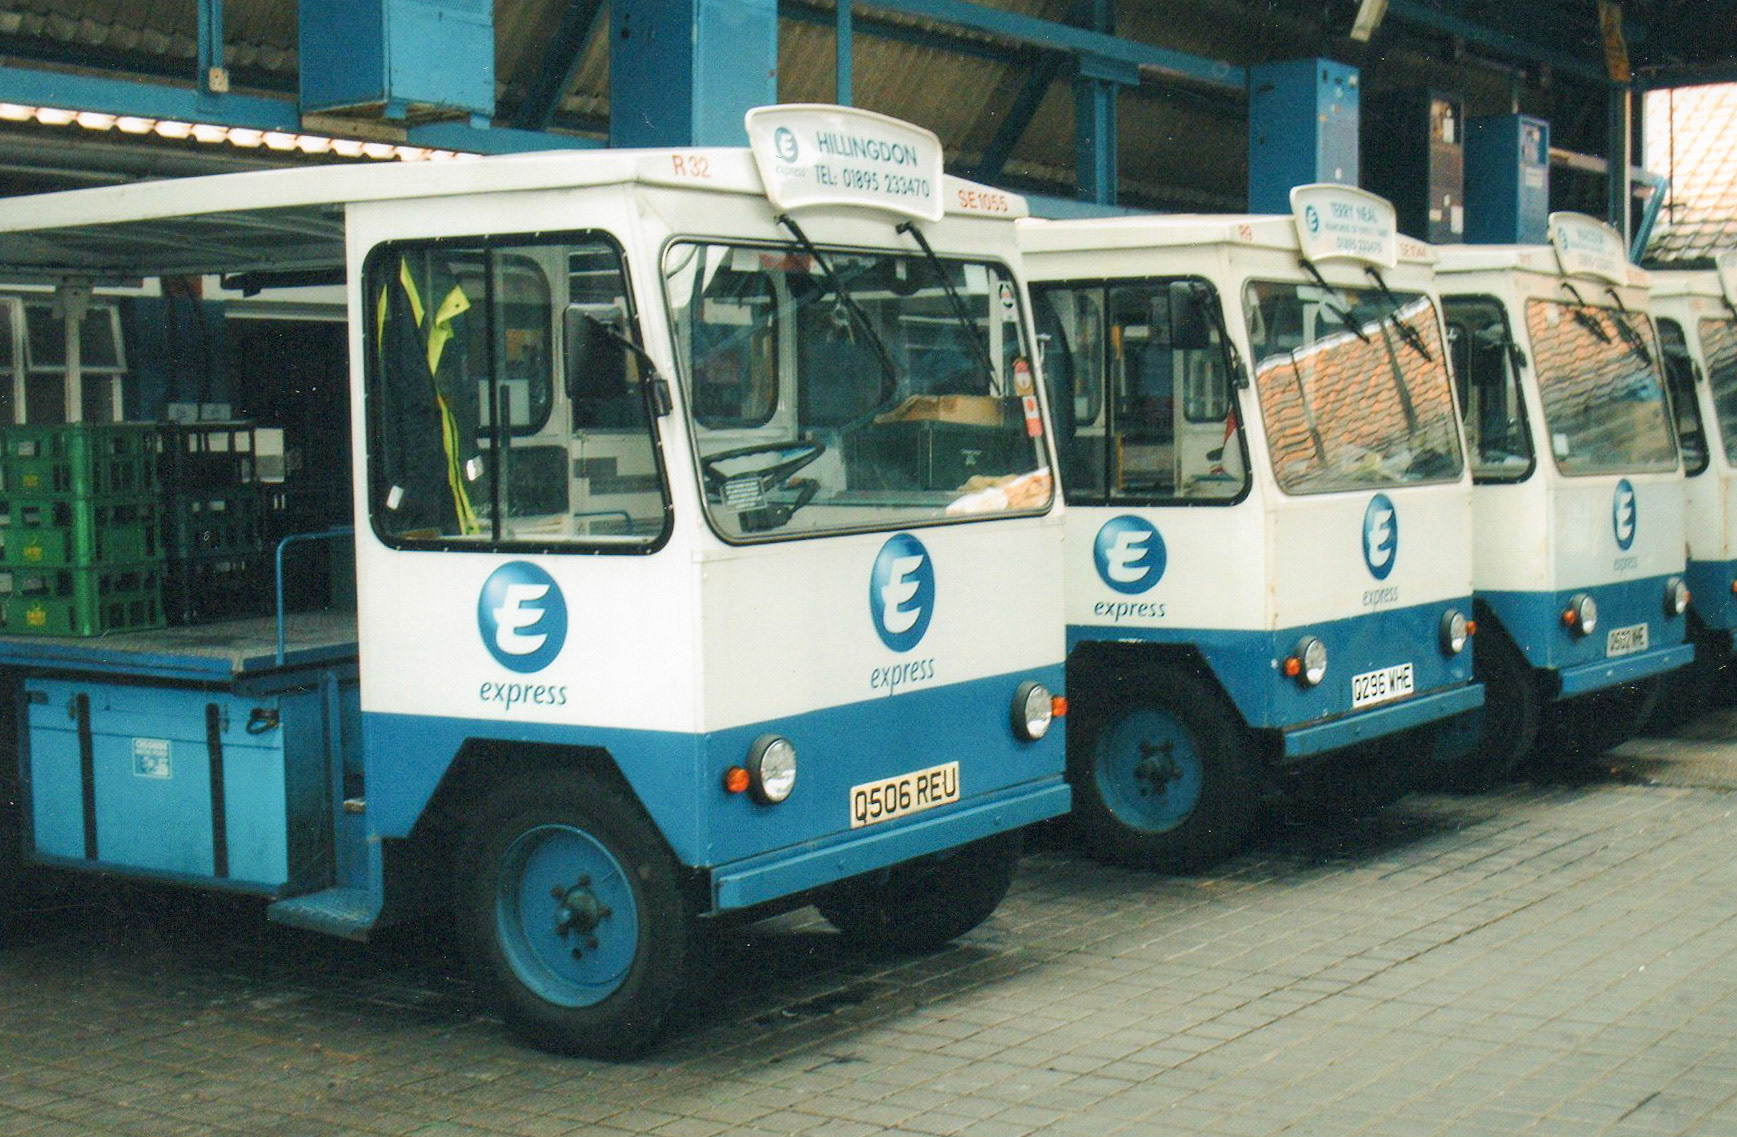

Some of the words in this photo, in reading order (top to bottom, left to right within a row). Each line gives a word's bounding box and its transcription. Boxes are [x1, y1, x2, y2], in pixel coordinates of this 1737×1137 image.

[816, 131, 918, 167] HILLINGDON
[814, 165, 838, 185] TEL:
[843, 168, 879, 192] 01895
[884, 174, 930, 198] 233470
[958, 189, 1009, 213] SE1055
[1094, 600, 1166, 622] express
[1362, 586, 1398, 611] express
[870, 656, 935, 697] express
[1354, 672, 1386, 701] Q296
[1388, 665, 1411, 692] WHE
[479, 678, 568, 710] express
[855, 779, 911, 824] Q506
[917, 768, 956, 806] REU
